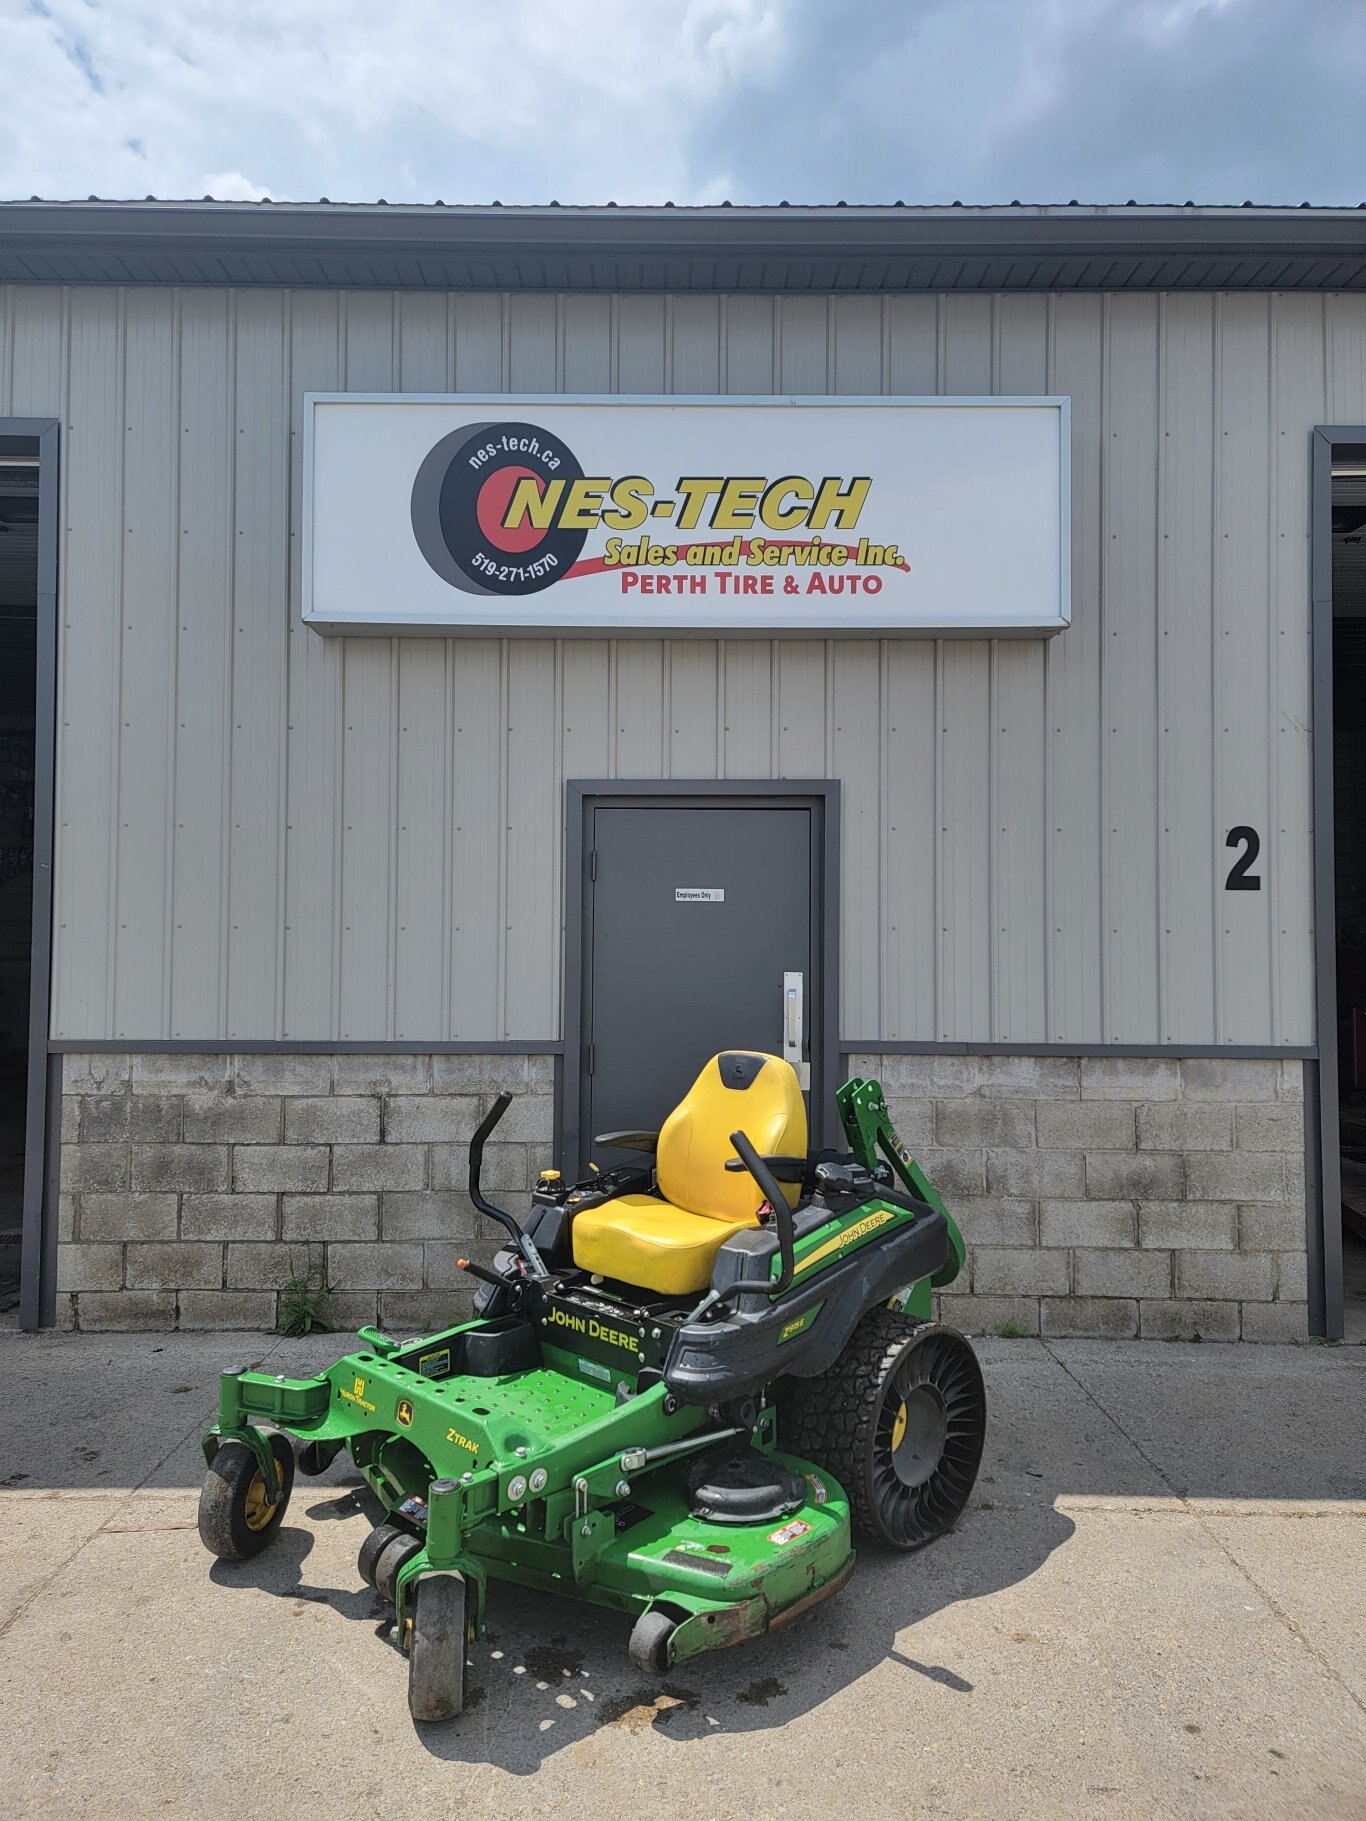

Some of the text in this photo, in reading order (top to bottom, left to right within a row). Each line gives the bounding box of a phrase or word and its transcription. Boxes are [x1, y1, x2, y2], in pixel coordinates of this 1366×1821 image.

[468, 435, 561, 471] nes-tech.ca
[500, 475, 873, 530] NES-TECH
[471, 552, 559, 582] 519-271-1570
[602, 535, 906, 567] Sales and Service Inc.
[621, 572, 882, 595] PERTH TIRE & AUTO
[1225, 825, 1261, 890] 2
[676, 891, 711, 900] Employees Only
[839, 1213, 885, 1248] JOHN DEERE
[547, 1306, 639, 1353] JOHN DEERE
[446, 1427, 480, 1455] ZTRAK
